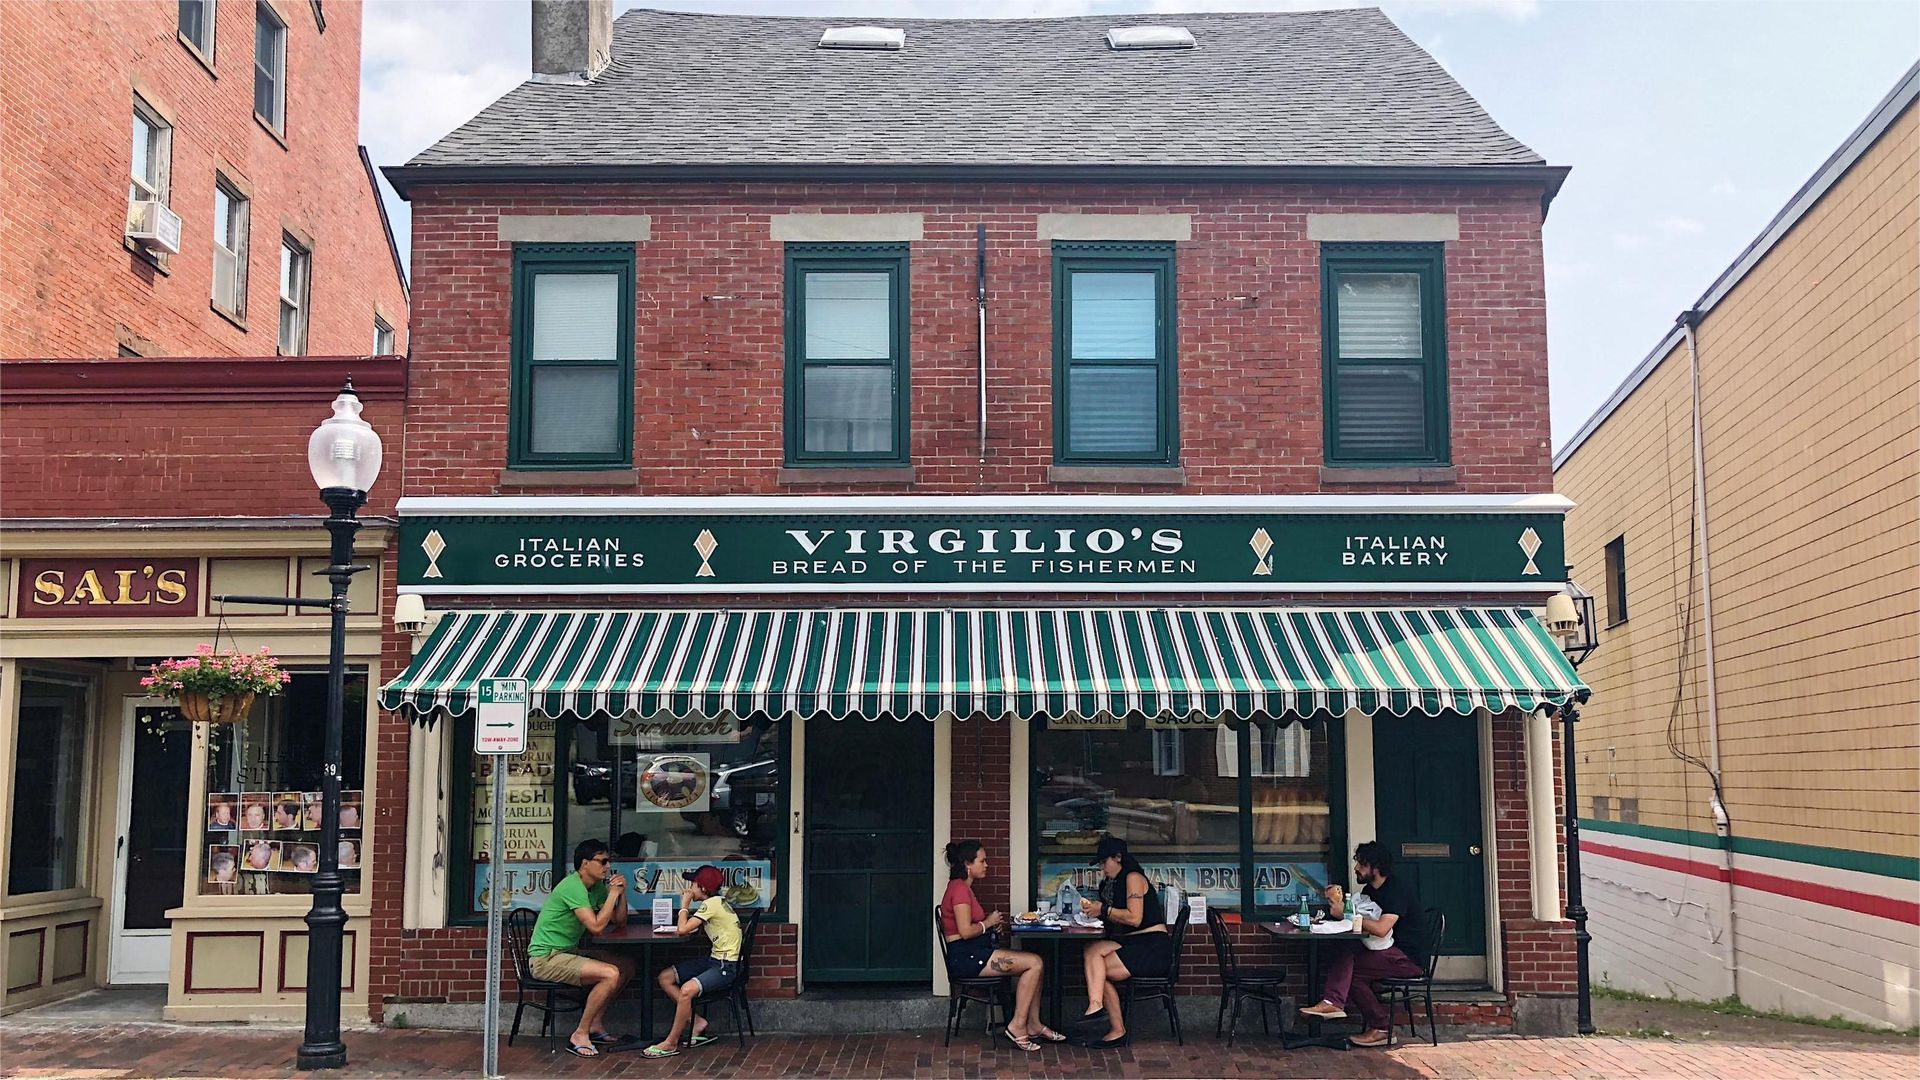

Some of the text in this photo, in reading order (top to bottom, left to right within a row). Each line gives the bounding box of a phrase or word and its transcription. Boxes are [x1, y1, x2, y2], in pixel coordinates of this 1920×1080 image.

[520, 537, 620, 552] ITALIAN
[786, 528, 1183, 556] VIRGILIO'S
[1346, 536, 1445, 550] ITALIAN
[495, 553, 644, 568] GROCERIES
[1342, 552, 1448, 566] BAKERY
[773, 560, 1196, 574] BREAD OF THE FISHERMEN
[33, 565, 188, 605] SAL'S
[481, 681, 517, 697] 15 MIN
[494, 693, 524, 702] PARKING
[613, 710, 732, 737] Sandwich
[480, 763, 551, 777] BEAD
[478, 850, 550, 862] BEAD
[1196, 866, 1291, 891] BRAD
